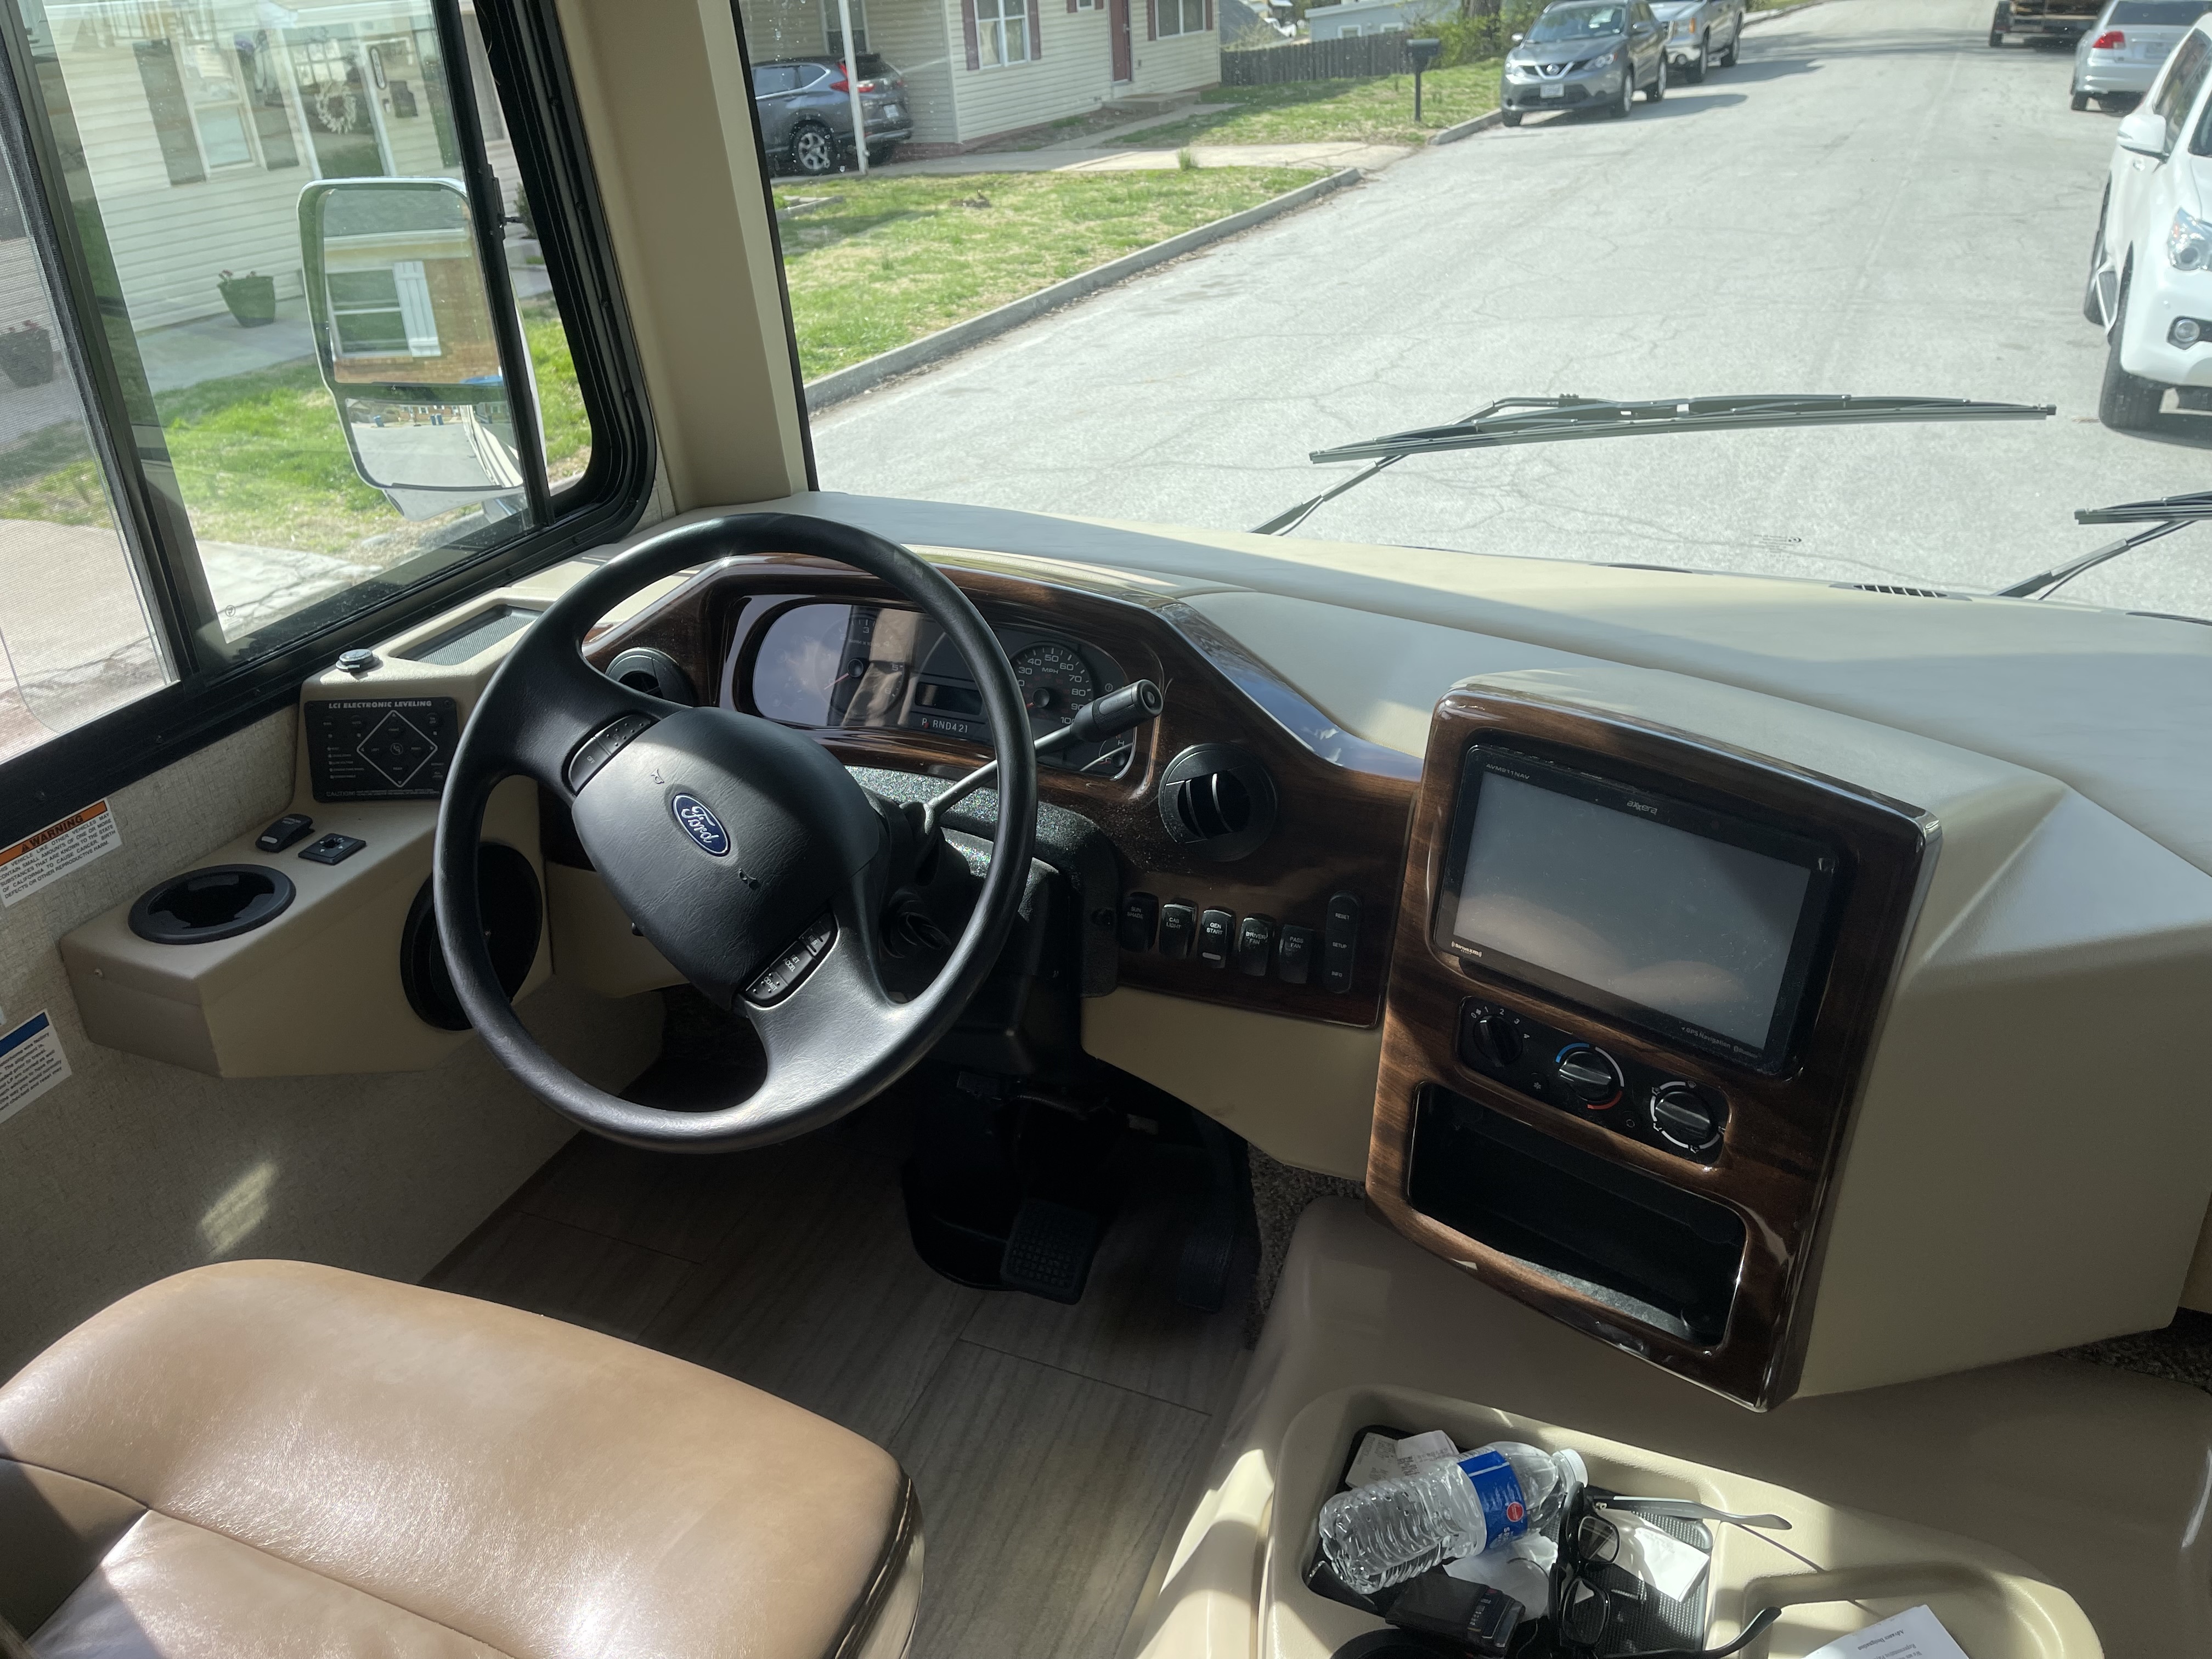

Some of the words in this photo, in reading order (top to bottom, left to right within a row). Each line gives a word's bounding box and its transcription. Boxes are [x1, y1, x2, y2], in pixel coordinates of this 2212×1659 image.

[1018, 667, 1032, 675] 30
[1069, 674, 1082, 682] 70
[30, 815, 84, 847] WARNING
[681, 806, 719, 843] Ford
[11, 853, 33, 867] VEHICLE
[36, 844, 48, 854] LIKE
[51, 833, 69, 845] OTHER
[71, 819, 97, 834] VEHICLES
[99, 812, 110, 821] MAY
[22, 857, 40, 868] SMALL
[41, 843, 66, 859] AMOUNTS
[76, 832, 87, 840] ONE
[97, 819, 112, 828] MORE
[0, 866, 35, 887] SUBSTANCES
[35, 859, 48, 868] THAT
[49, 853, 60, 861] ARE
[60, 842, 80, 854] KNOWN
[88, 832, 98, 840] THE
[99, 825, 114, 835] STATE
[13, 868, 44, 887] CALIFORNIA
[56, 853, 75, 864] CAUSE
[101, 830, 116, 840] BIRTH
[5, 883, 29, 899] DEFECTS
[37, 869, 55, 881] OTHER
[55, 849, 93, 871] REPRODUCTIVE
[808, 935, 818, 945] RES
[783, 958, 795, 972] ACCEL
[791, 955, 800, 964] SET
[764, 976, 778, 991] COAST
[1686, 1027, 1699, 1036] GPS
[1699, 1031, 1731, 1048] Navigation
[1858, 1636, 1884, 1651] Designation
[1885, 1629, 1904, 1640] Advance
